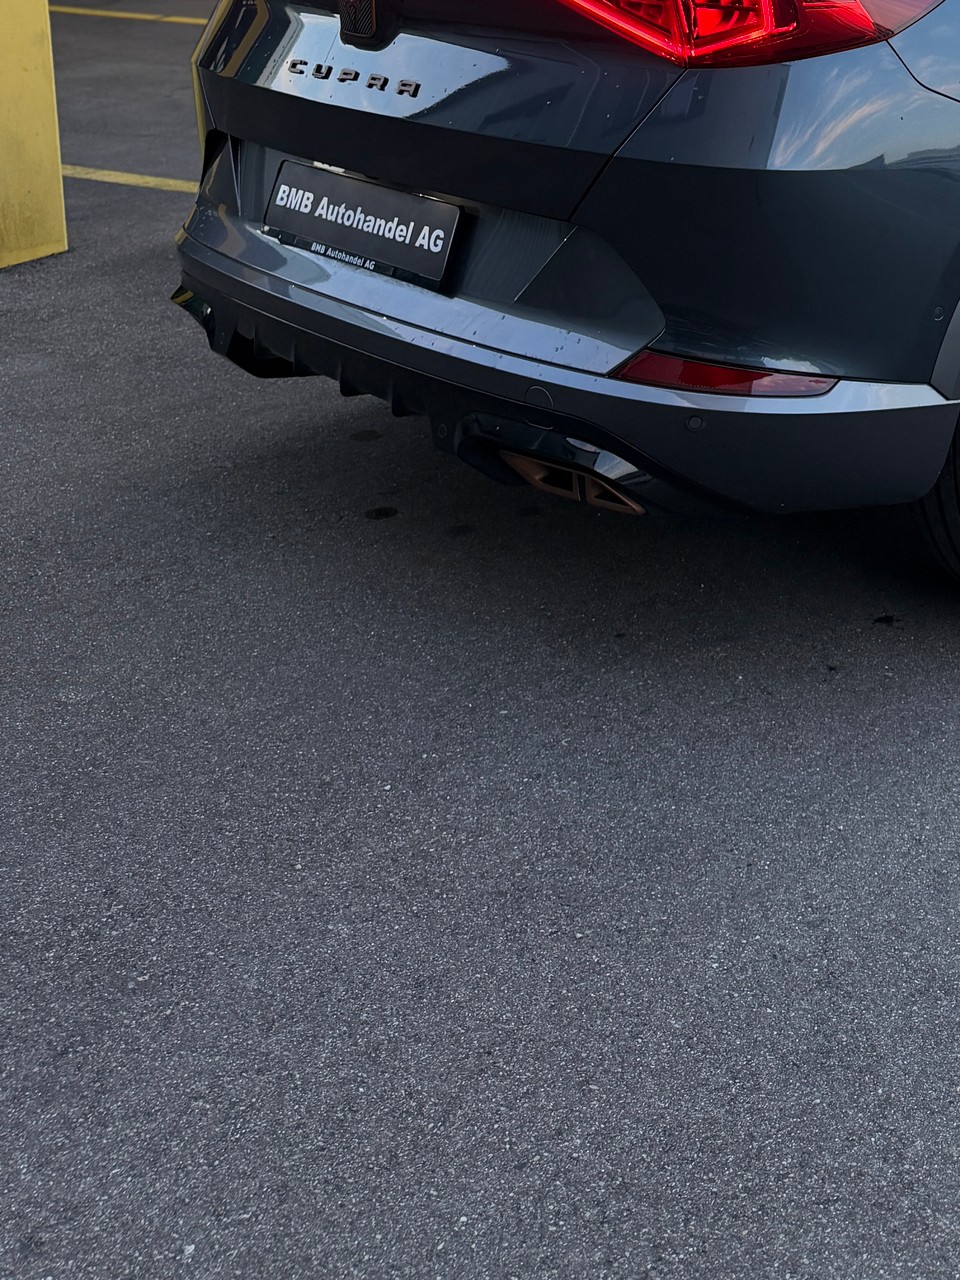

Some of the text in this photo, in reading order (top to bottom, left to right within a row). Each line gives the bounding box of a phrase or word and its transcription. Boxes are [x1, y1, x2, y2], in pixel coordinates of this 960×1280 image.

[287, 58, 422, 99] CUPRA
[275, 184, 445, 254] BMB Autohandel AG
[310, 241, 376, 271] BMB Autohandel AG
